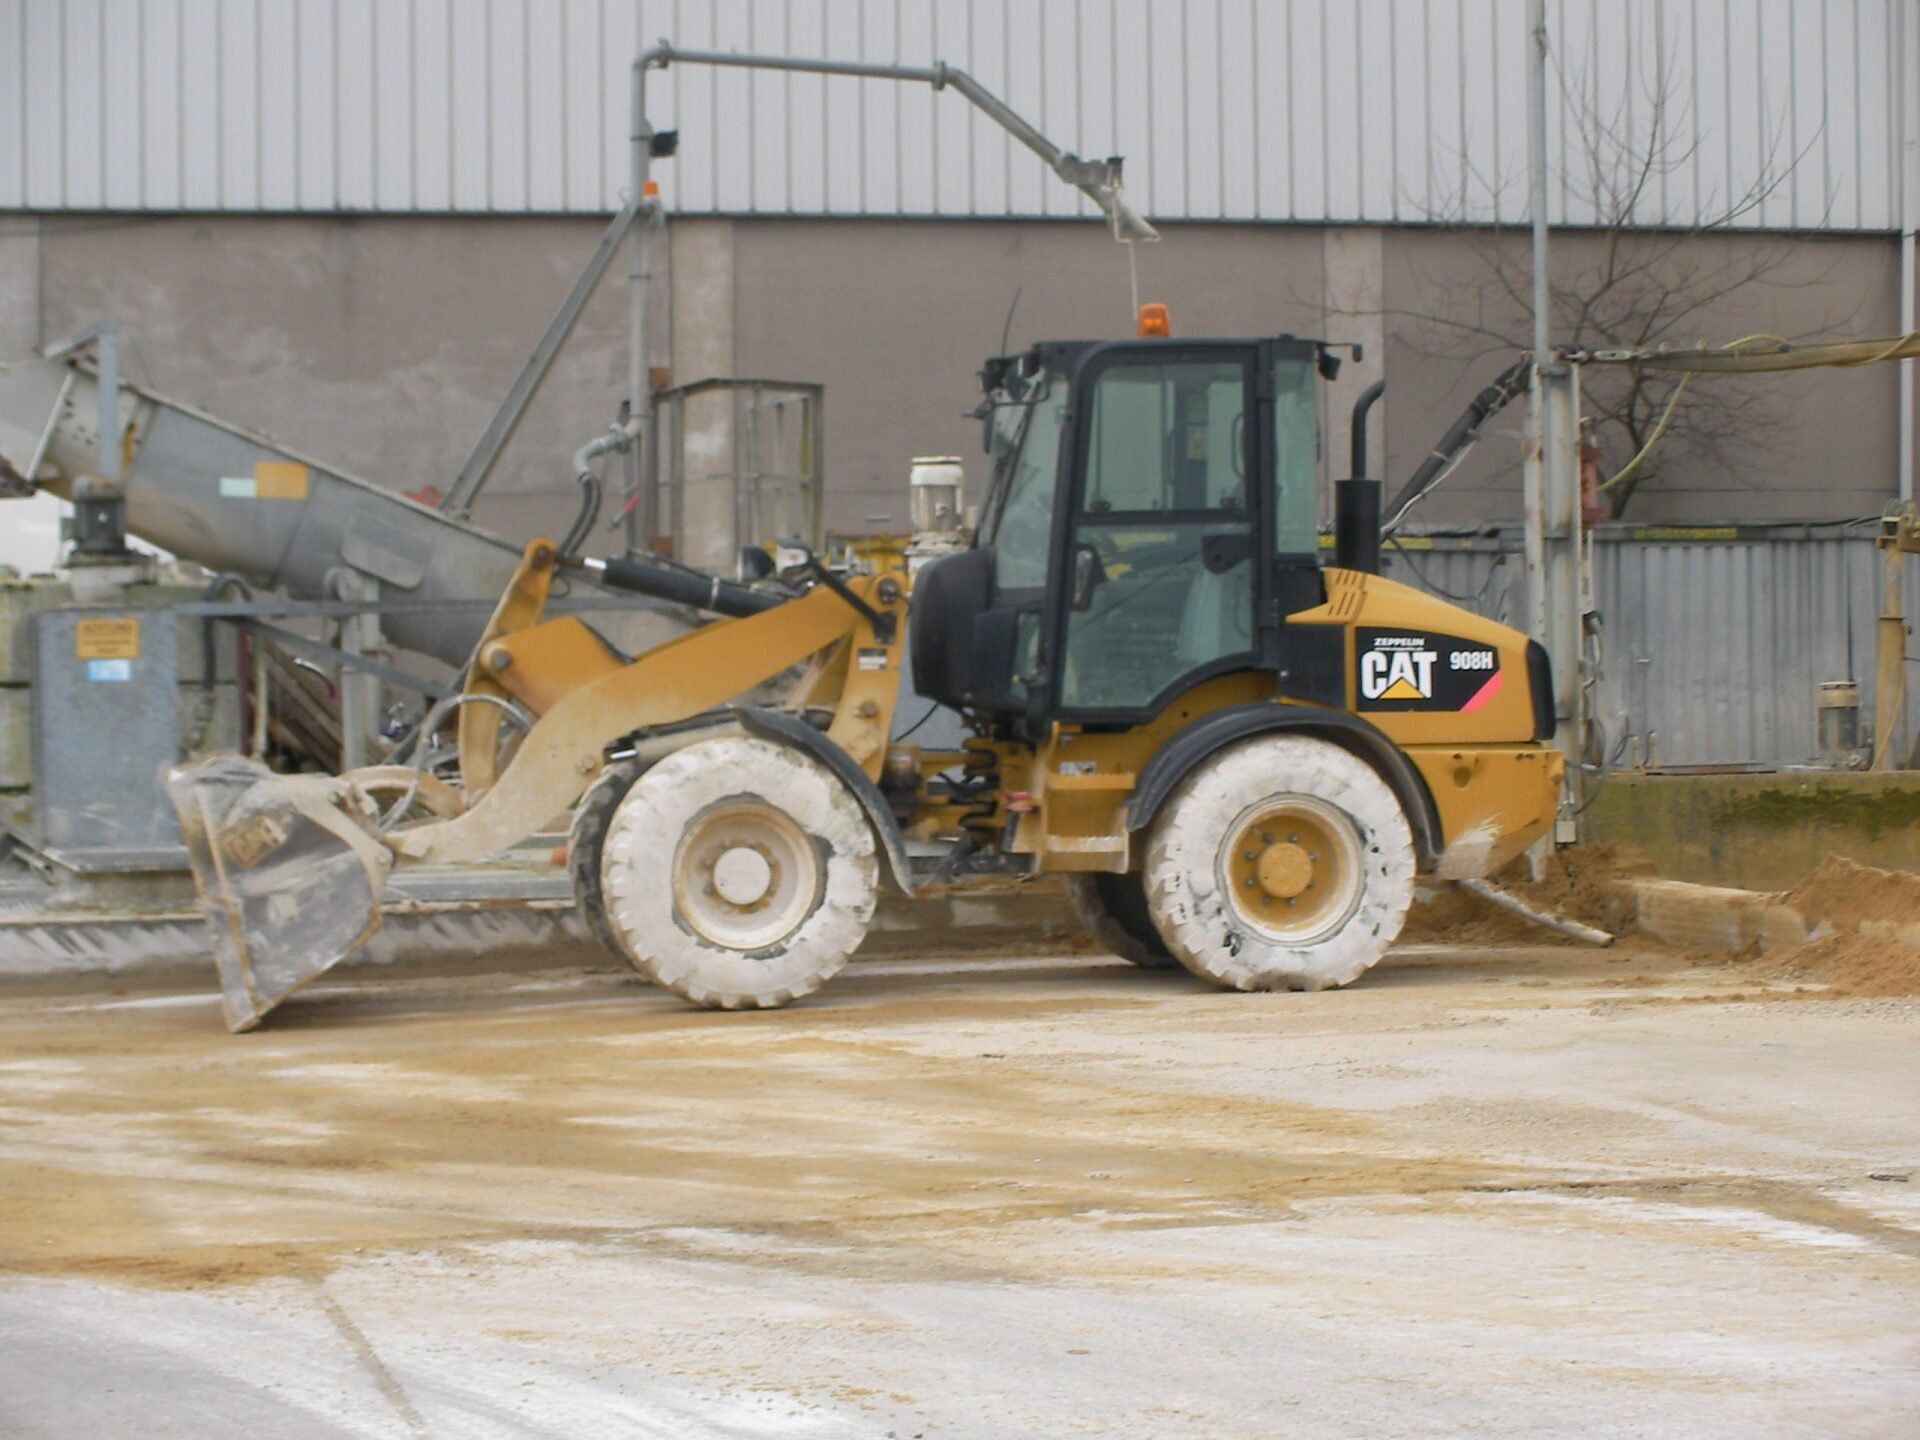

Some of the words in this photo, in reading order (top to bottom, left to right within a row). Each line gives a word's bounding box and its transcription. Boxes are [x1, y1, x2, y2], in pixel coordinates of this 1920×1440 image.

[1374, 637, 1425, 646] ZEPPELIN
[1450, 651, 1493, 670] 908H
[1361, 651, 1437, 699] CAT
